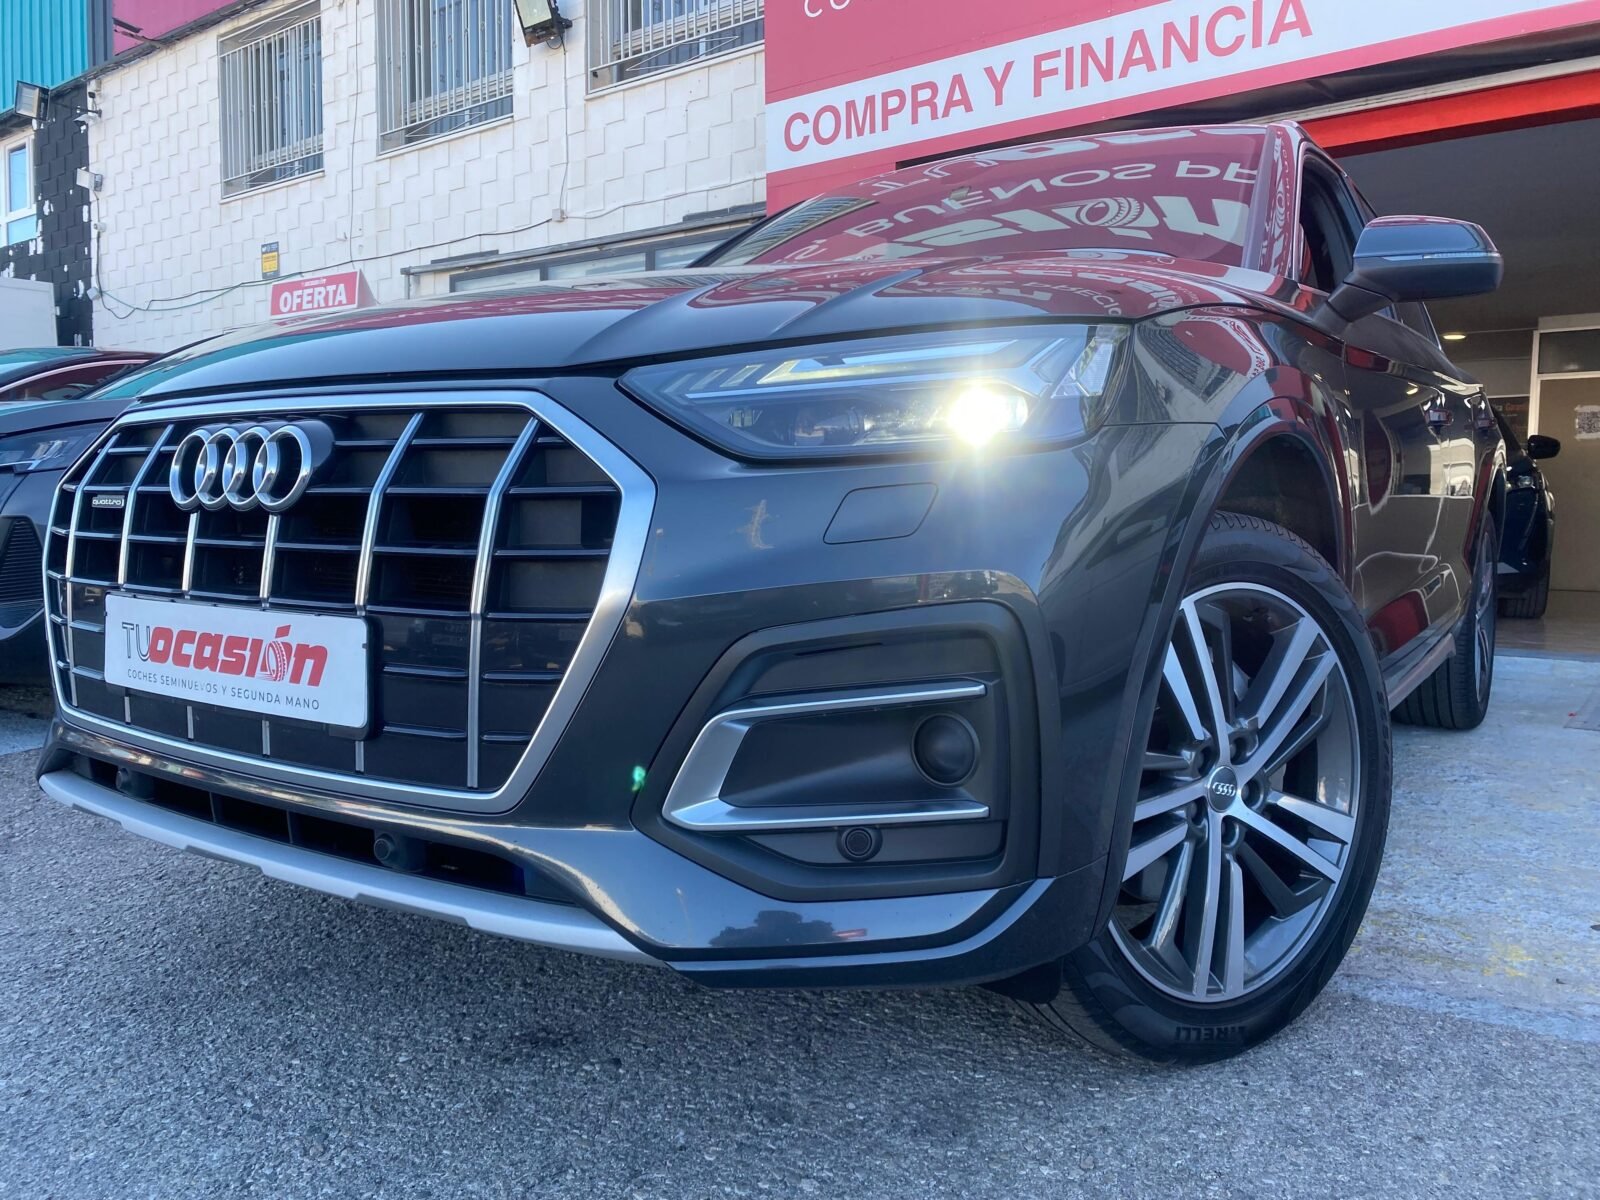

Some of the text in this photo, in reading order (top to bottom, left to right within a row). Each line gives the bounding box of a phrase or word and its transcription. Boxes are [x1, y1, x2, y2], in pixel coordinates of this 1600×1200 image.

[783, 0, 1313, 154] COMPRA Y FINANCIA
[278, 283, 347, 313] OFERTA
[92, 498, 122, 506] quattro
[127, 668, 320, 710] COCHES SEMINUEVOS Y SEGUNDA MANO
